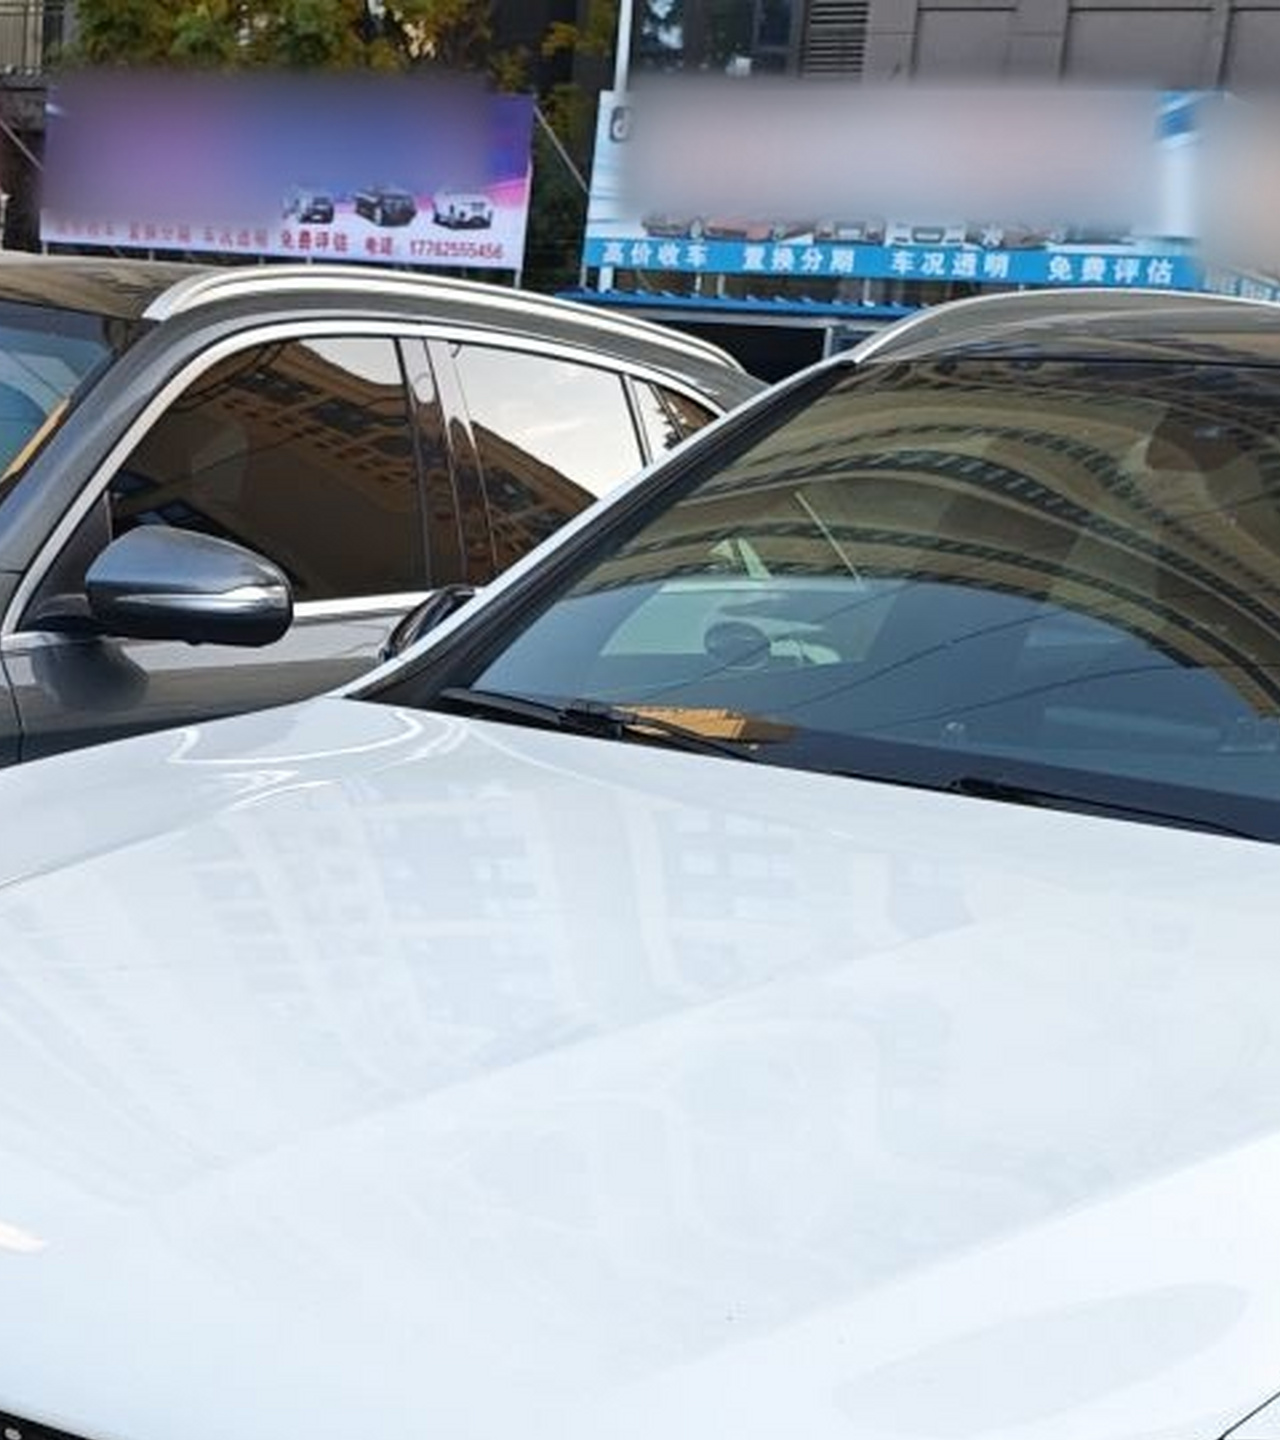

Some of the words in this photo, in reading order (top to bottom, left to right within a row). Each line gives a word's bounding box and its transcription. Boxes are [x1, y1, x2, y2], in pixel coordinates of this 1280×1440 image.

[603, 242, 708, 268] 高价收车
[743, 246, 855, 273] 置换分期
[891, 250, 1010, 278] 车况透明
[1048, 256, 1173, 283] 免费评估
